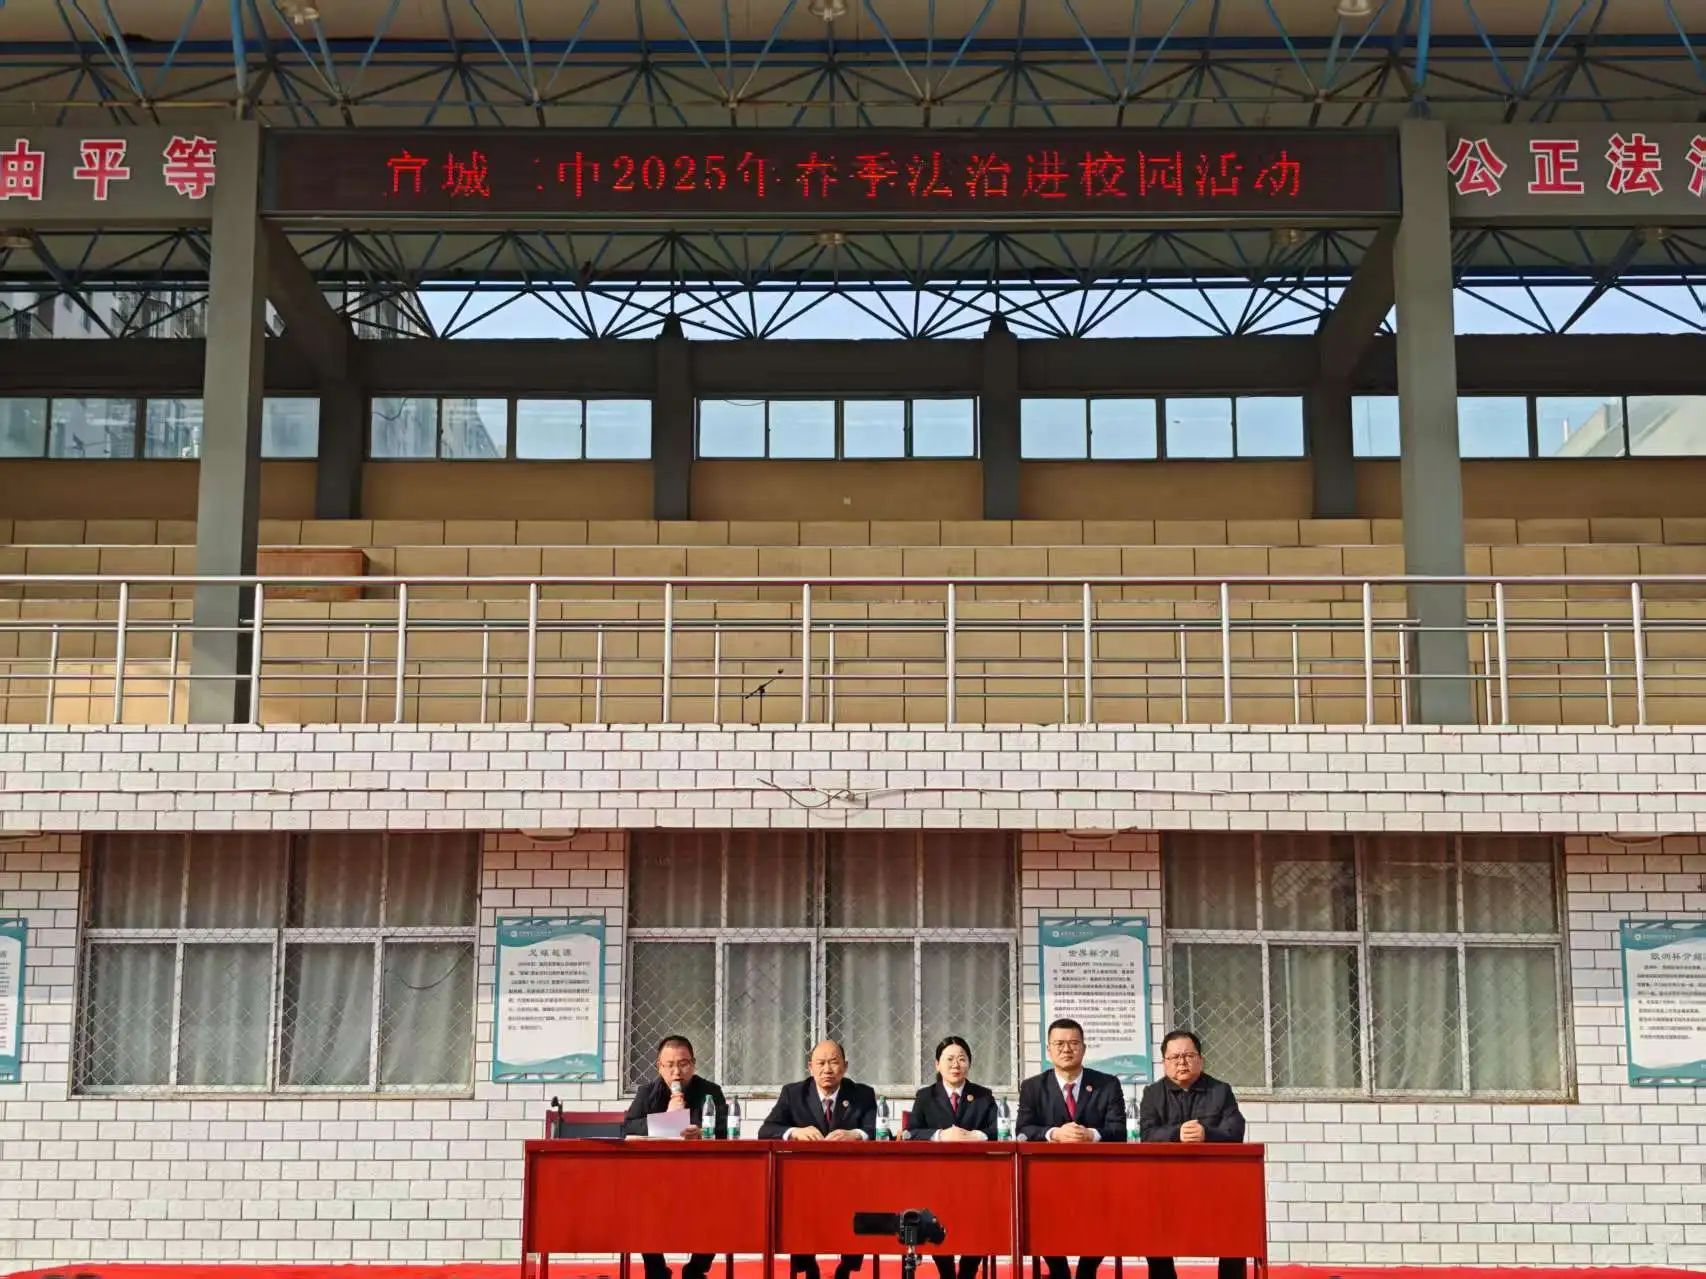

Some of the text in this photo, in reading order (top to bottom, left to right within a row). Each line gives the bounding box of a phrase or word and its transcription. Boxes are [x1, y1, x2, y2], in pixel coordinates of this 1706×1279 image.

[384, 149, 1302, 200] 宜城中2025年春季法治进校园活动
